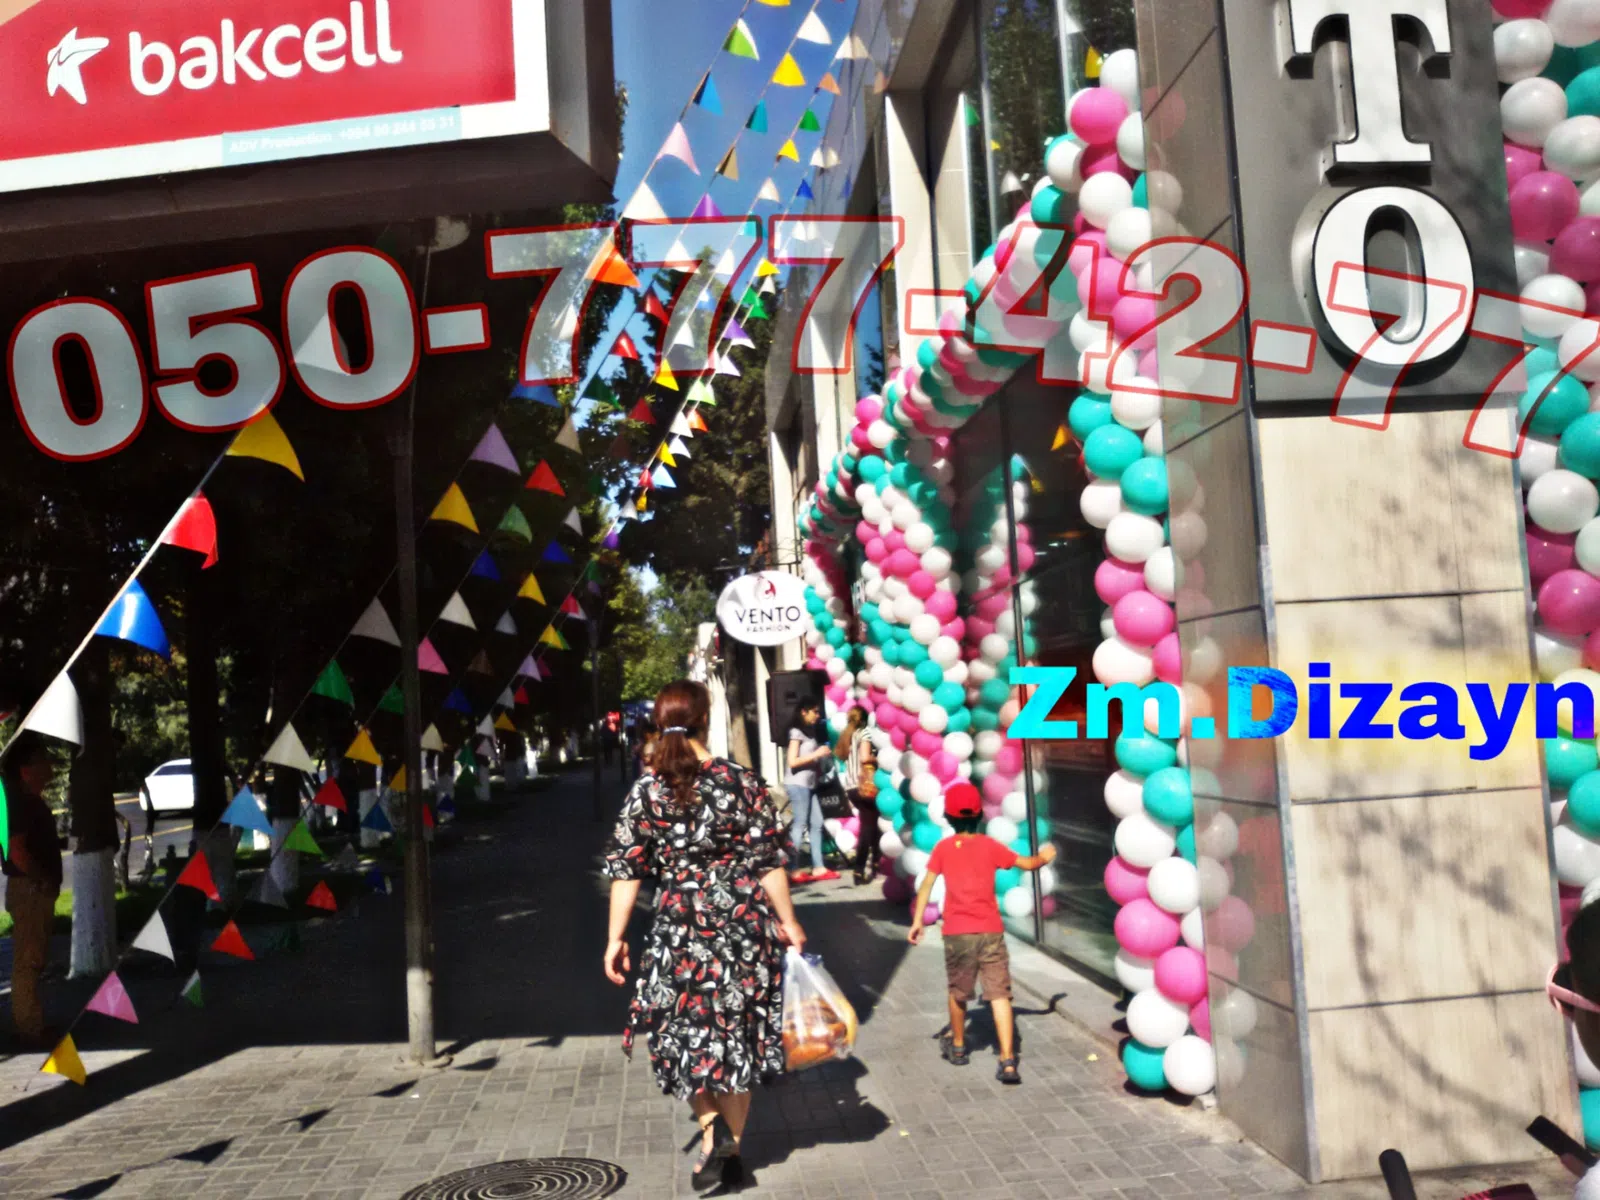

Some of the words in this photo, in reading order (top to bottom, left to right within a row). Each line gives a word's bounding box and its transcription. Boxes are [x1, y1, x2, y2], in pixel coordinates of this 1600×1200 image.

[128, 0, 403, 96] bakcell
[735, 606, 801, 624] VENTO
[746, 624, 791, 632] FASHION
